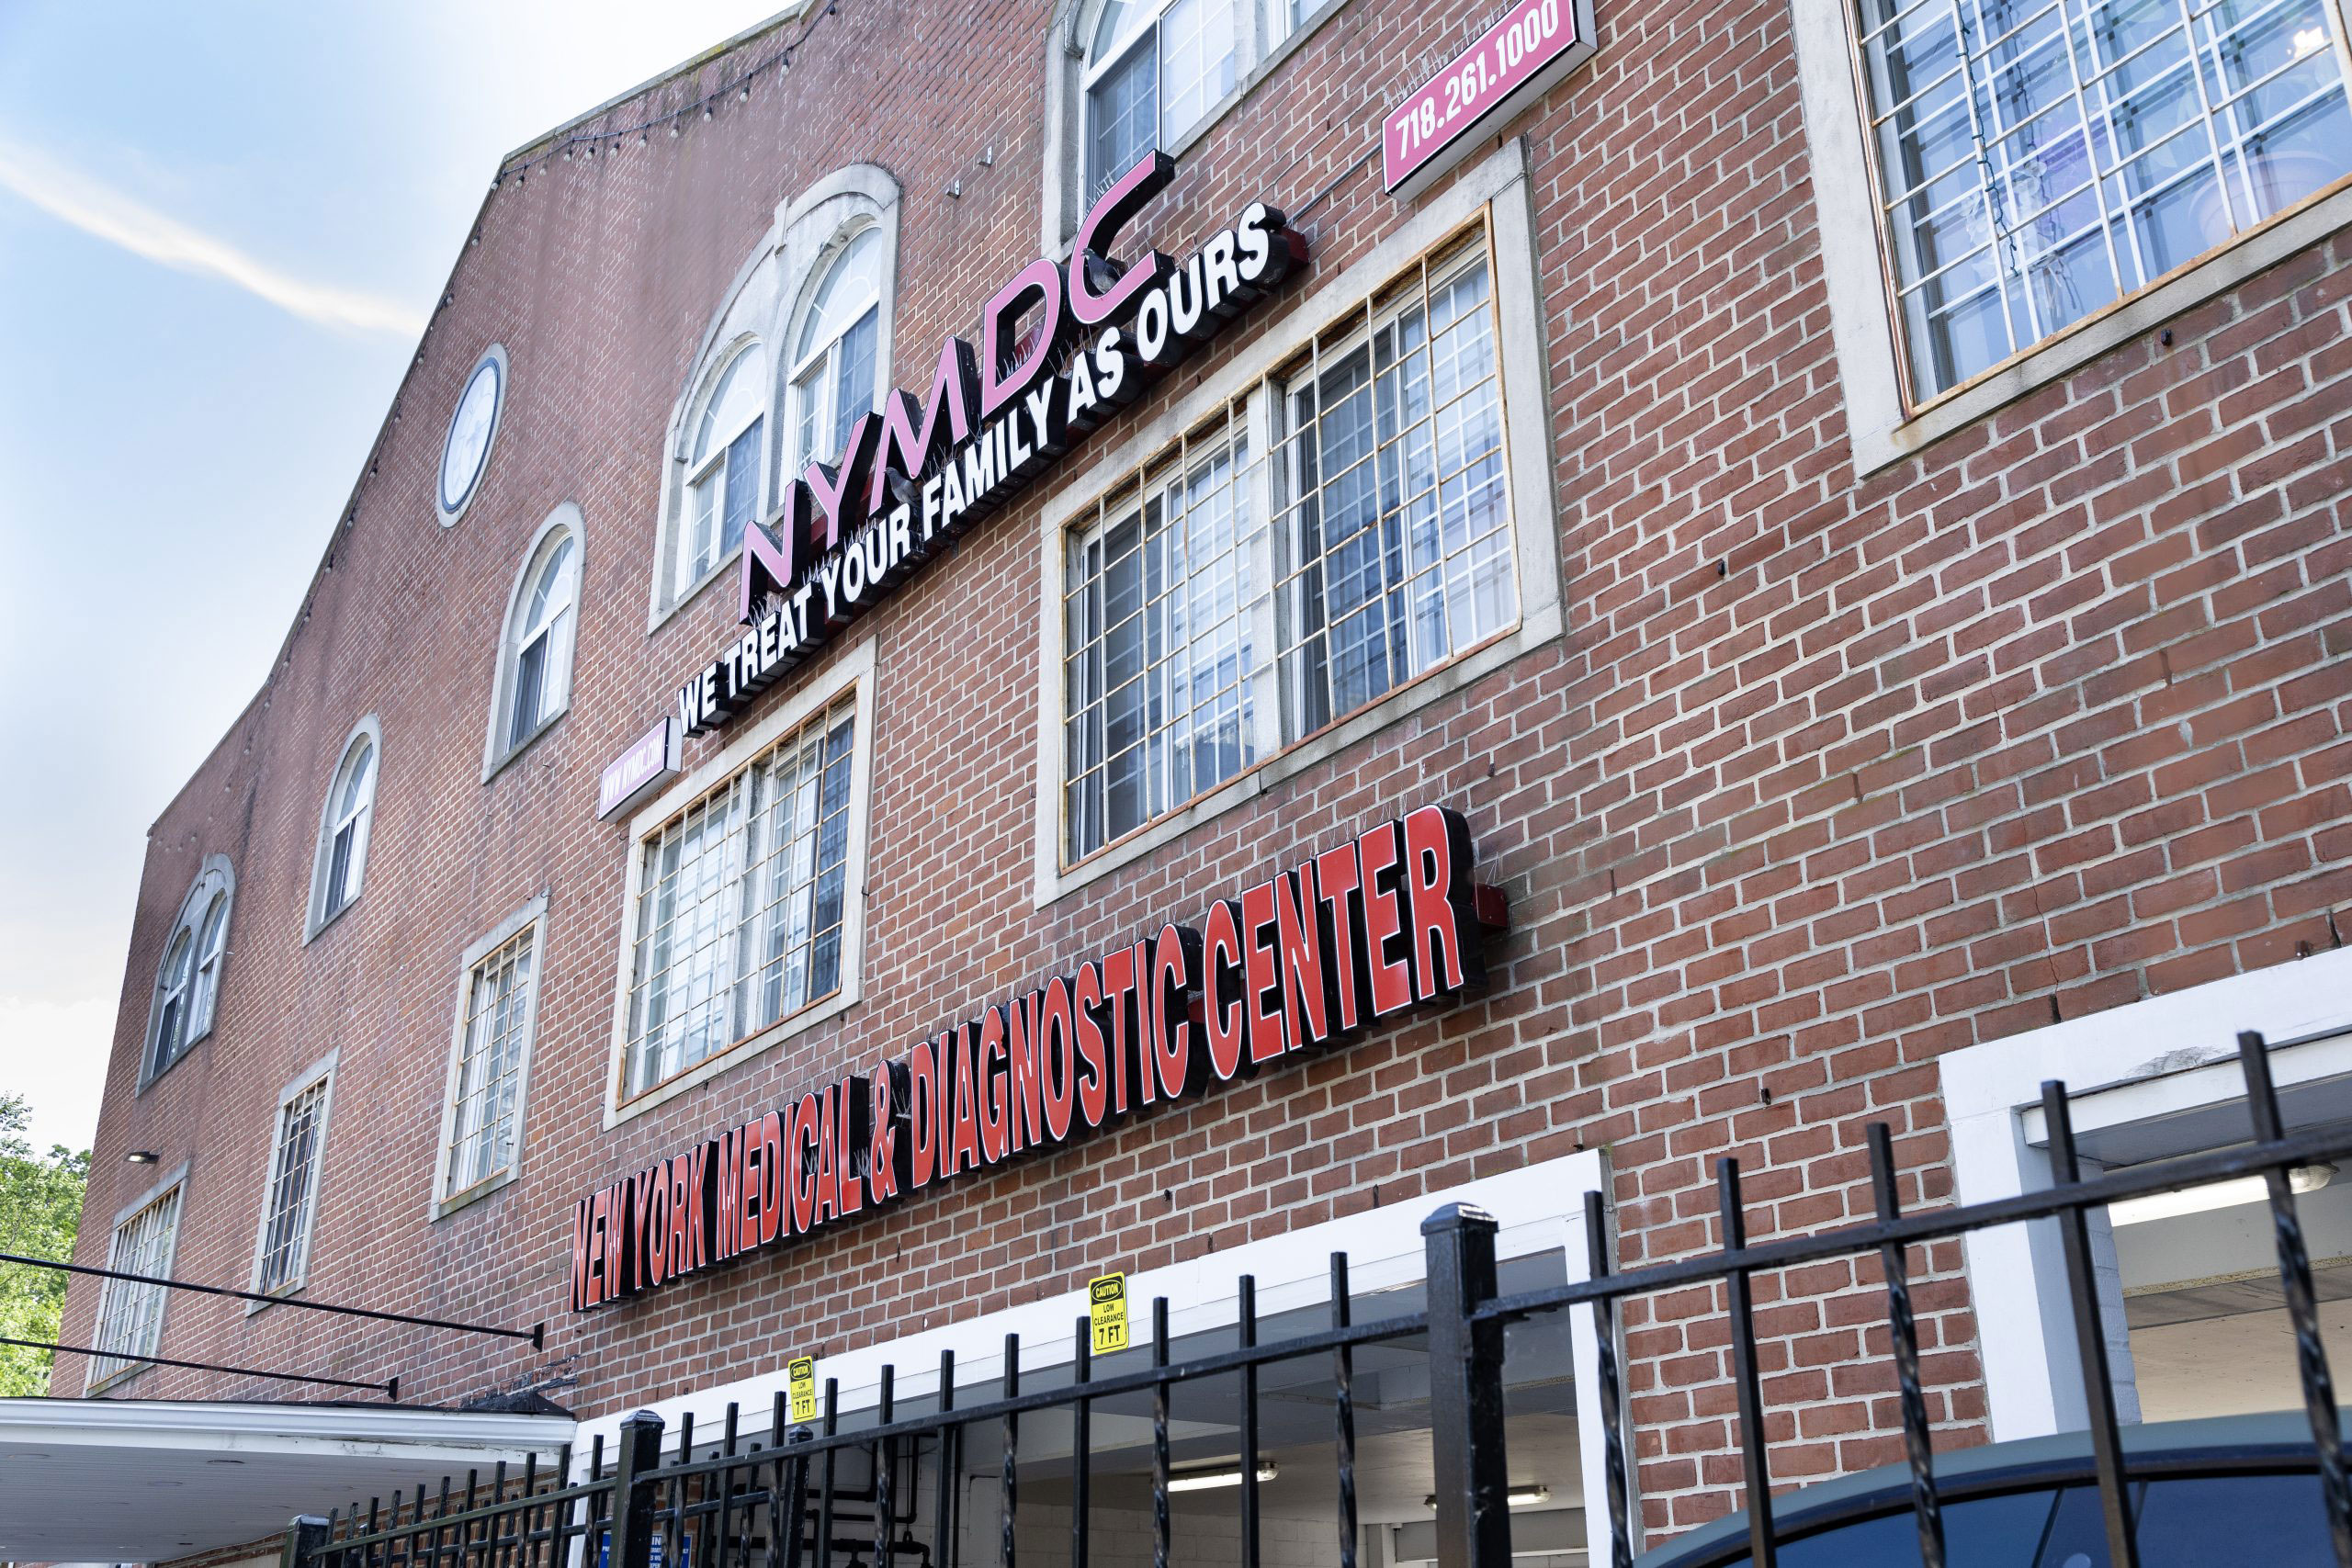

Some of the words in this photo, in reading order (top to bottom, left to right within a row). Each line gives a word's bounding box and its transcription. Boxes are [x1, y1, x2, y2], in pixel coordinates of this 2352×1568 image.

[1395, 0, 1559, 161] 718.261.1000
[739, 148, 1157, 625] NYMDC
[678, 661, 717, 736] WE
[723, 581, 812, 699] TREAT
[820, 502, 910, 619] YOUR
[922, 375, 1055, 542] FAMILY
[1069, 326, 1125, 424] AS
[1136, 202, 1270, 362] OURS
[570, 1178, 629, 1314] NEW
[634, 1141, 710, 1291] YORK
[716, 1076, 863, 1261] MEDICAL
[870, 1059, 898, 1204] &
[910, 922, 1189, 1189] DIAGNOSTIC
[1203, 804, 1464, 1081] CENTER
[1095, 1282, 1119, 1298] CAUTION
[1102, 1303, 1114, 1314] LOW
[1094, 1312, 1124, 1326] CLEARANCE
[1099, 1327, 1104, 1345] 7
[1108, 1325, 1121, 1343] FT
[792, 1388, 813, 1400] CLEARANCE
[796, 1401, 800, 1416] 7
[802, 1399, 810, 1415] FT
